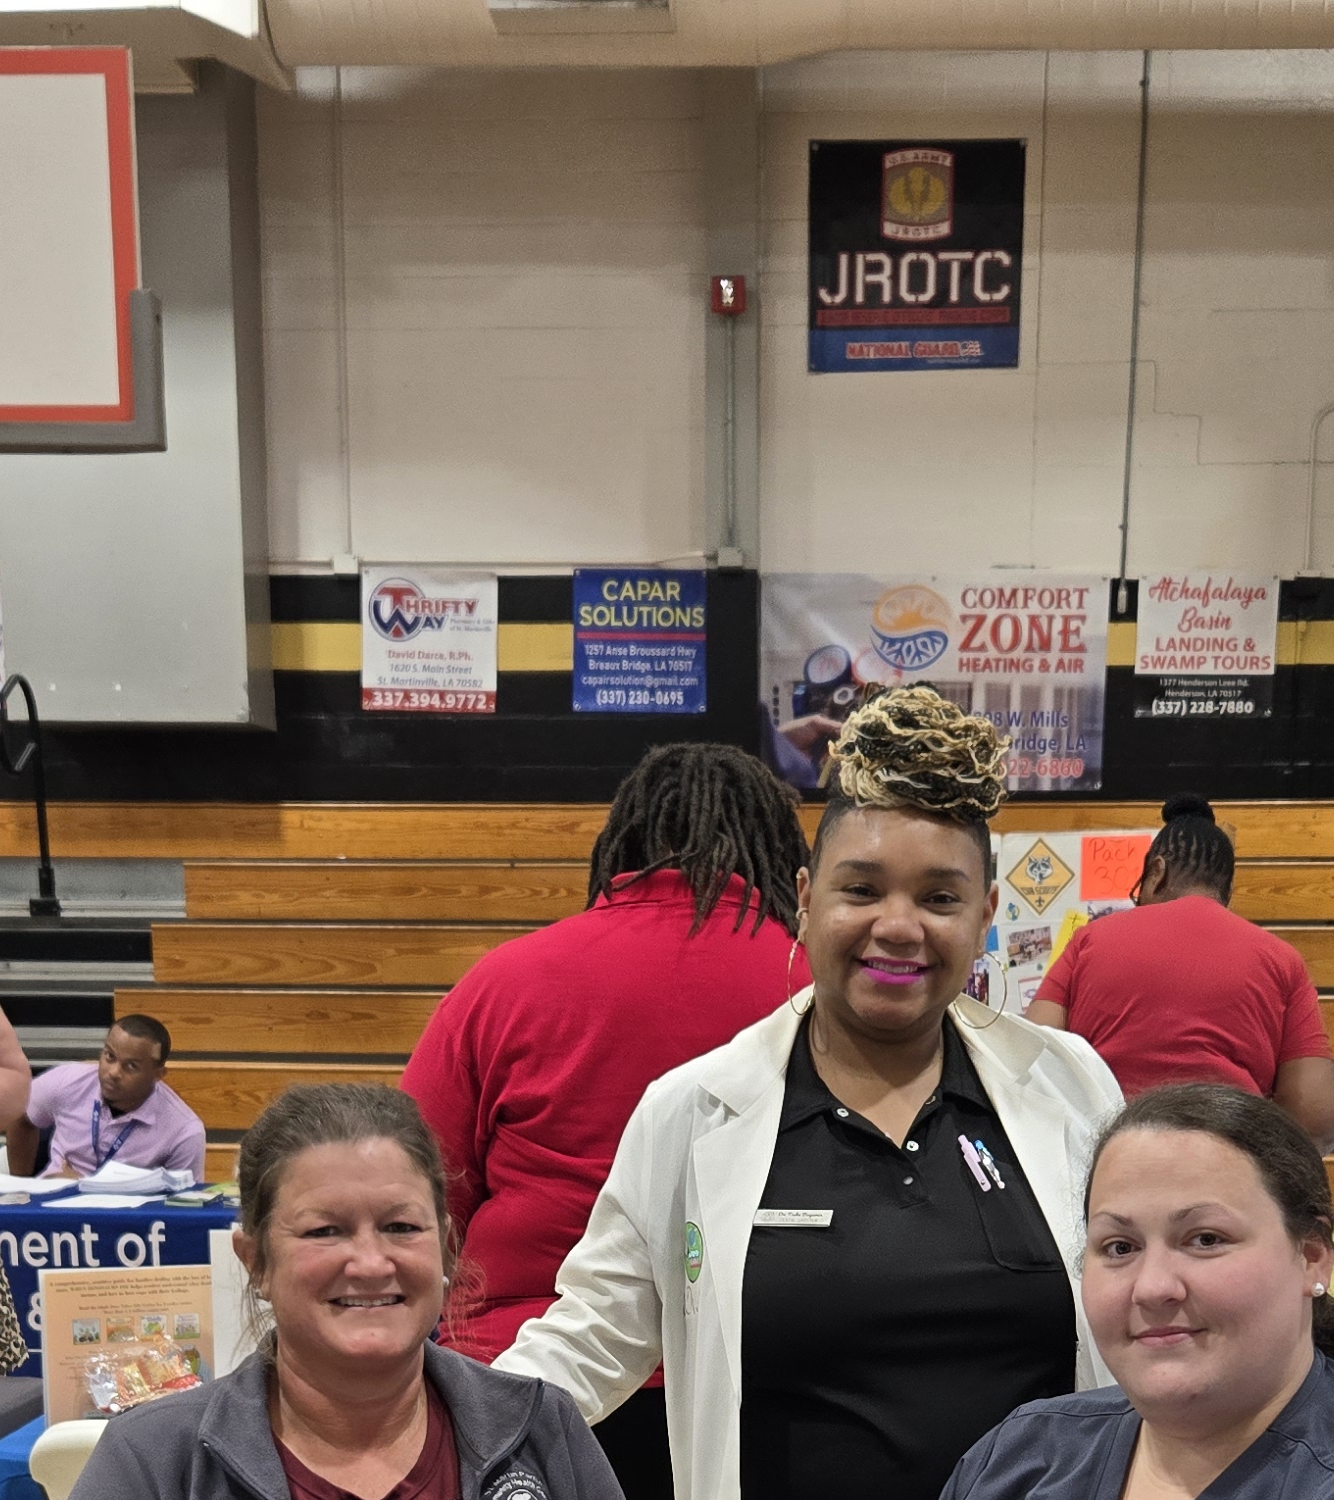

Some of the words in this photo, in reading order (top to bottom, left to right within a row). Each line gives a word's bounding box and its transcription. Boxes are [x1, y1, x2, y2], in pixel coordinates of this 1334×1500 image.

[817, 250, 1012, 304] JROTC
[602, 580, 681, 602] CAPAR
[960, 587, 1089, 610] COMFORT
[1148, 576, 1268, 610] Atchafalaya
[376, 586, 479, 617] THRIFTY
[579, 605, 705, 627] SOLUTIONS
[1177, 606, 1232, 633] Basin
[957, 613, 1088, 654] ZONE
[606, 645, 627, 656] Anse
[628, 645, 676, 657] Broussard
[1155, 637, 1239, 652] LANDING
[1243, 637, 1256, 652] &
[387, 650, 416, 660] David
[1140, 655, 1208, 670] SWAMP
[1211, 655, 1271, 671] TOURS
[422, 665, 444, 674] Main
[447, 665, 472, 675] Street
[588, 659, 621, 671] Breaux
[654, 660, 667, 671] LA
[957, 657, 1035, 674] HEATING
[1037, 658, 1053, 674] &
[1054, 657, 1084, 674] AIR
[1178, 678, 1218, 687] Henderson
[372, 691, 487, 710] 337.394.9772
[596, 689, 626, 707] (337)
[628, 690, 685, 706] 230-0695
[1151, 699, 1187, 717] (337)
[1030, 711, 1069, 728] Mills
[1066, 735, 1088, 751] LA
[1088, 837, 1138, 862] Pack
[116, 1220, 166, 1268] of
